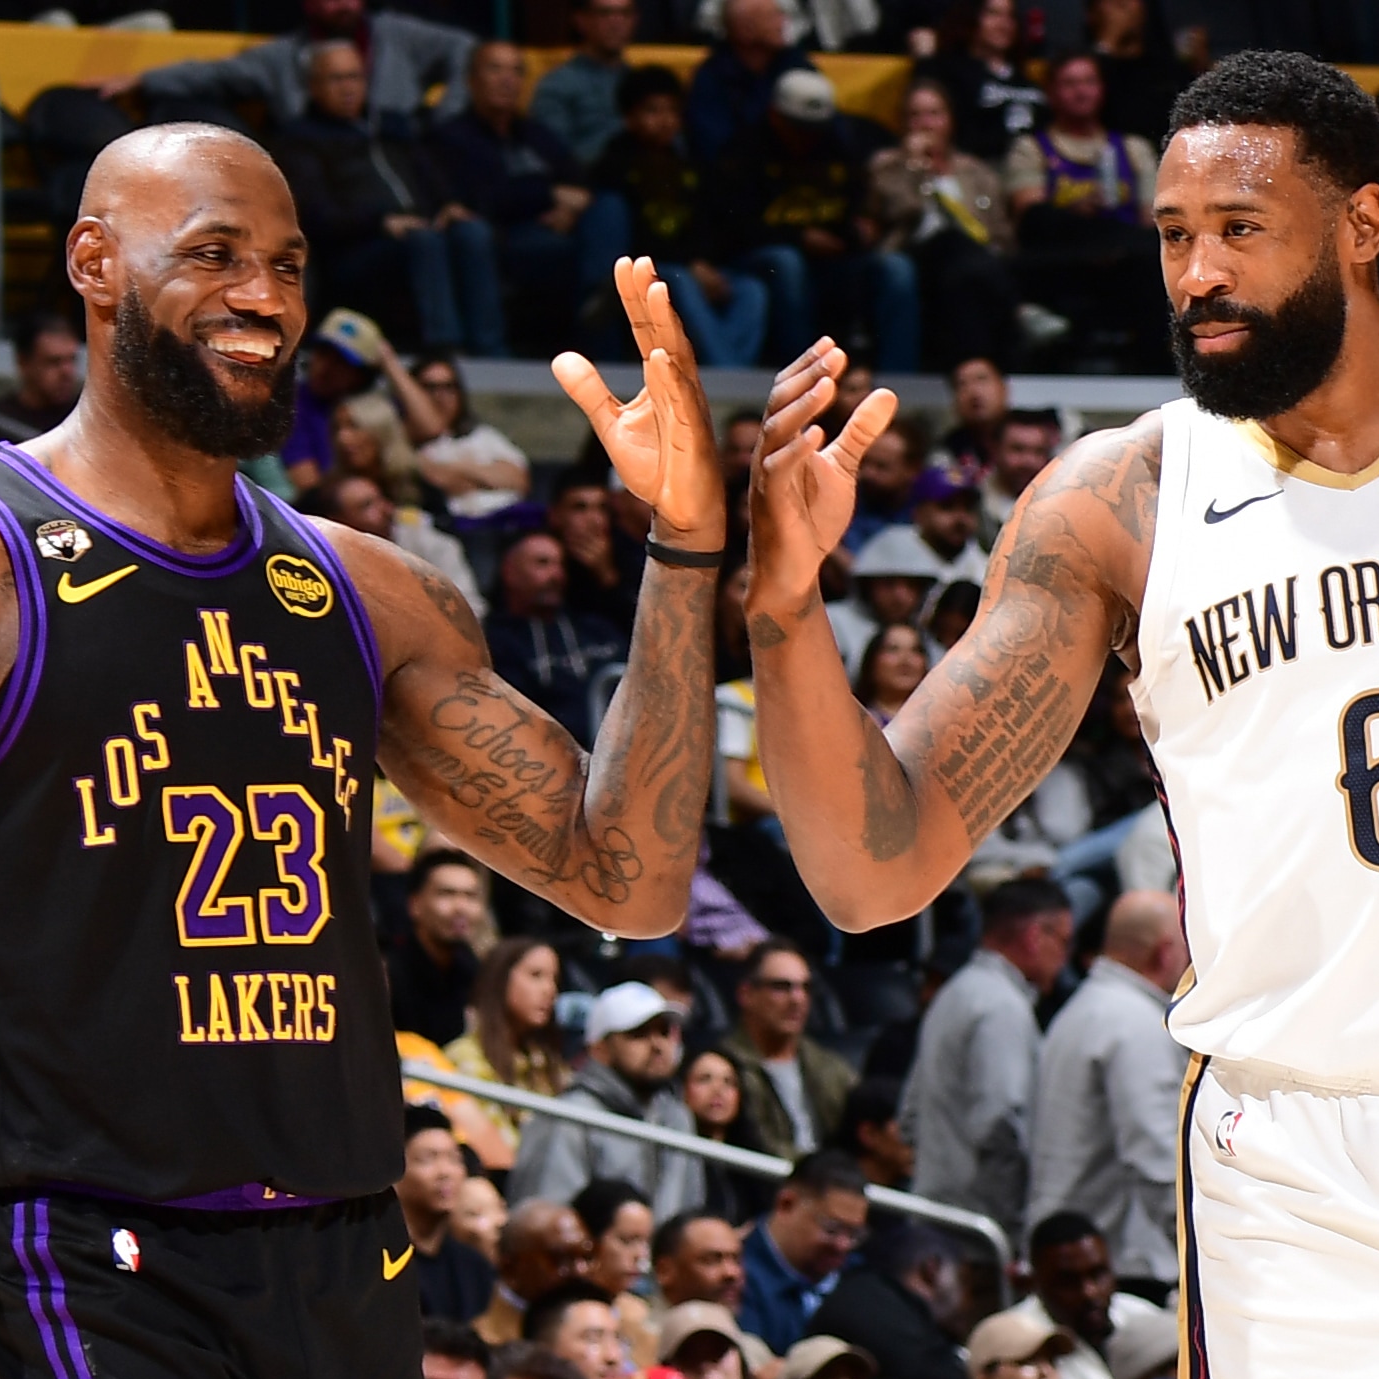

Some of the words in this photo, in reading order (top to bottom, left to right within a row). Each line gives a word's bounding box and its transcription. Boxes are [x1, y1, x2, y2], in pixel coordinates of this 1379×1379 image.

[270, 568, 326, 601] bibigo
[1184, 574, 1299, 707] NEW
[73, 700, 171, 847] LOS
[162, 784, 331, 947] 23
[172, 971, 336, 1043] LAKERS
